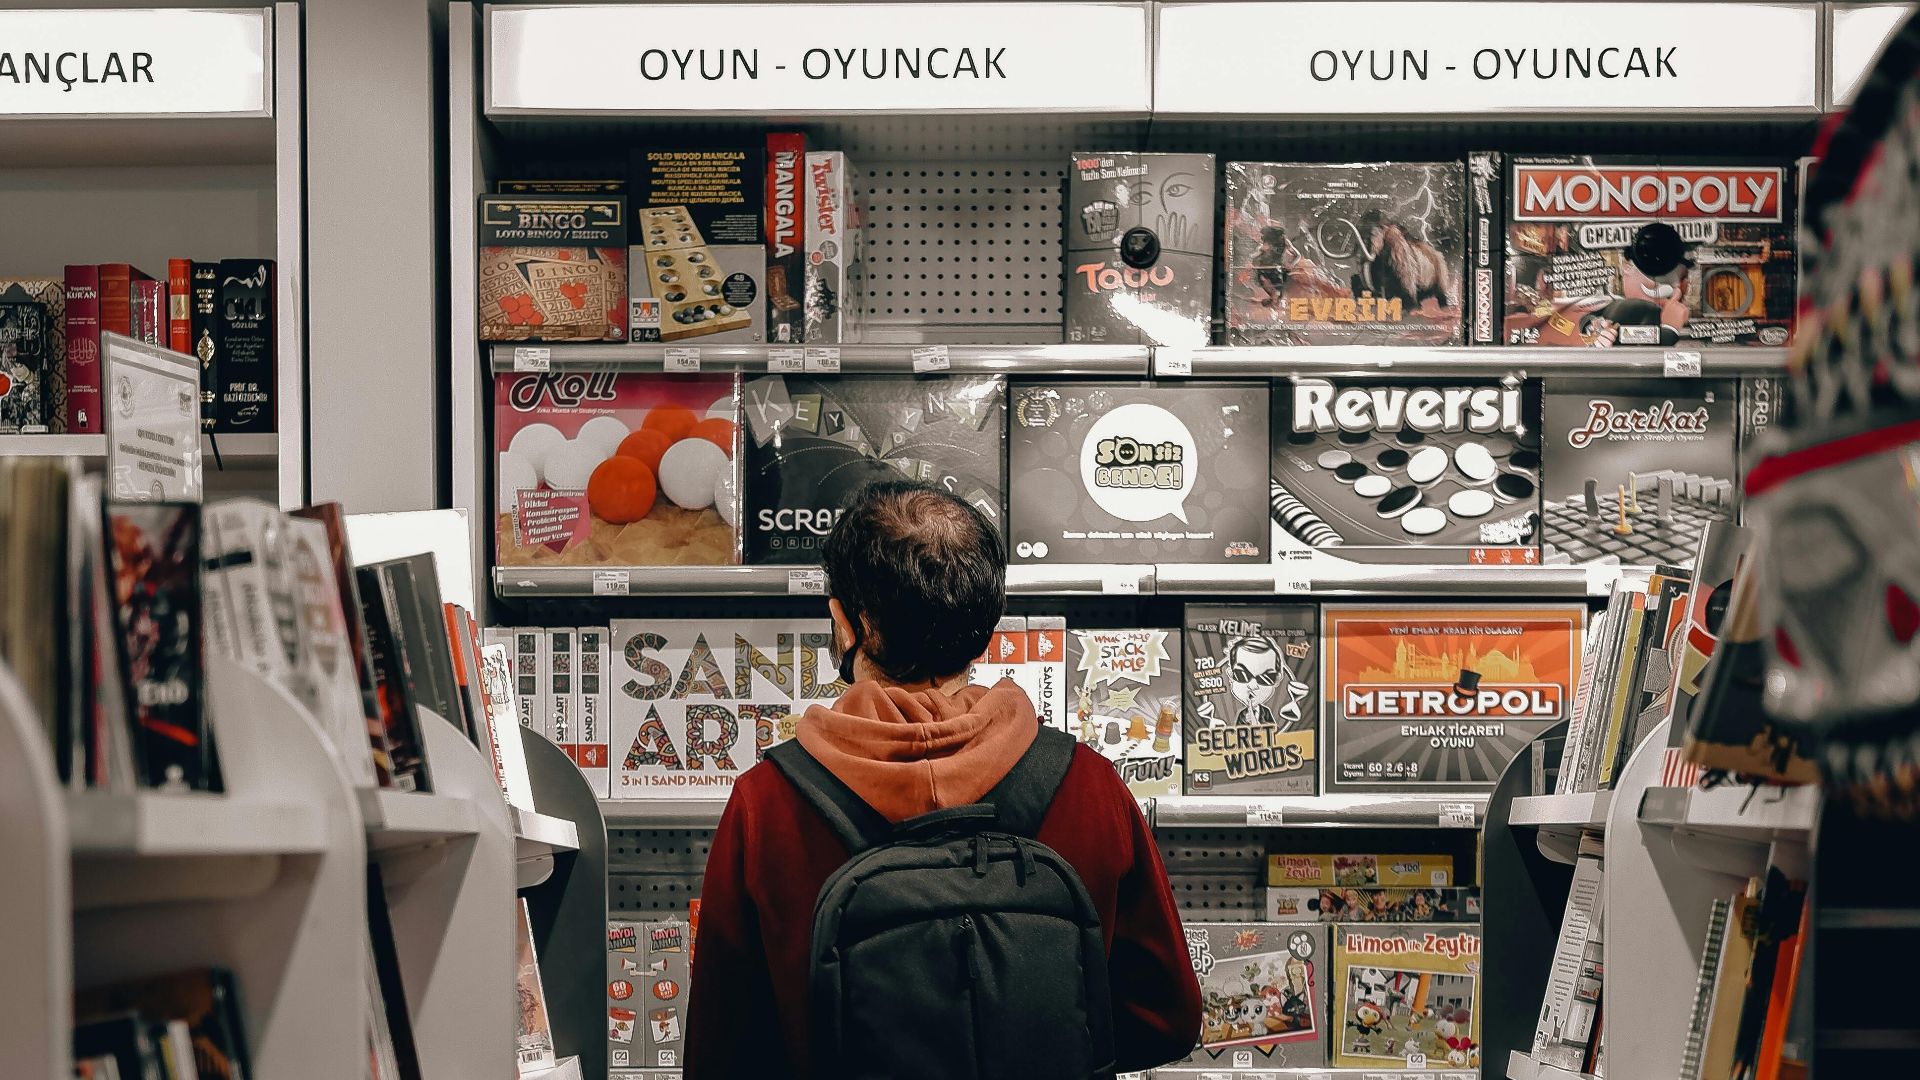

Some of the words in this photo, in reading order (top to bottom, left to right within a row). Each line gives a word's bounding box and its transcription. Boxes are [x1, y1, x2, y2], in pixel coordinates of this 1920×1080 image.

[0, 52, 155, 92] ANÇLAR
[640, 48, 758, 80] OYUN
[802, 47, 1007, 80] OYUNCAK
[1310, 49, 1428, 81] OYUN
[1473, 46, 1678, 80] OYUNCAK
[647, 152, 673, 160] SOLID
[674, 152, 701, 160] WOOD
[1524, 174, 1774, 215] MONOPOLY
[775, 151, 795, 259] MANGALA
[518, 213, 586, 229] BINGO
[495, 230, 525, 239] LOTO
[526, 230, 561, 239] BINGO
[535, 264, 599, 278] BINGO
[66, 291, 97, 300] KUR'AN
[1289, 290, 1402, 321] EVRİM
[1478, 271, 1491, 340] MONOPOLY
[508, 372, 617, 412] Roll
[1293, 378, 1522, 433] Reversi
[1568, 400, 1709, 448] Barikat
[1096, 436, 1154, 465] SON
[1096, 465, 1183, 489] BENDE!
[1219, 619, 1262, 637] KELİME
[1389, 626, 1409, 635] YENİ
[1411, 626, 1440, 635] EMLAK
[1100, 642, 1146, 659] STACK
[621, 631, 851, 699] SAND
[1194, 656, 1215, 670] 720
[1043, 666, 1053, 699] SAND
[1199, 676, 1223, 689] 3600
[522, 697, 530, 715] ART
[556, 695, 565, 714] ART
[585, 696, 593, 715] ART
[1349, 690, 1553, 715] METROPOL
[1043, 701, 1053, 724] ART
[585, 716, 593, 742] SAND
[621, 703, 792, 771] ART
[1401, 725, 1446, 736] EMLAK
[1449, 723, 1504, 736] TİCARETİ
[1197, 725, 1276, 754] SECRET
[1430, 737, 1475, 748] OYUNU
[1123, 755, 1176, 784] FUN!
[1224, 744, 1303, 779] WORDS
[1368, 762, 1383, 773] 60
[621, 775, 630, 786] 3
[632, 777, 642, 786] IN
[651, 775, 687, 786] SAND
[688, 775, 738, 786] PAINTIN
[1194, 772, 1210, 782] KS
[1277, 856, 1311, 868] Limon
[1285, 866, 1321, 879] Zeytin
[1346, 933, 1407, 953] Limon
[612, 981, 627, 992] 60
[658, 981, 673, 992] 60
